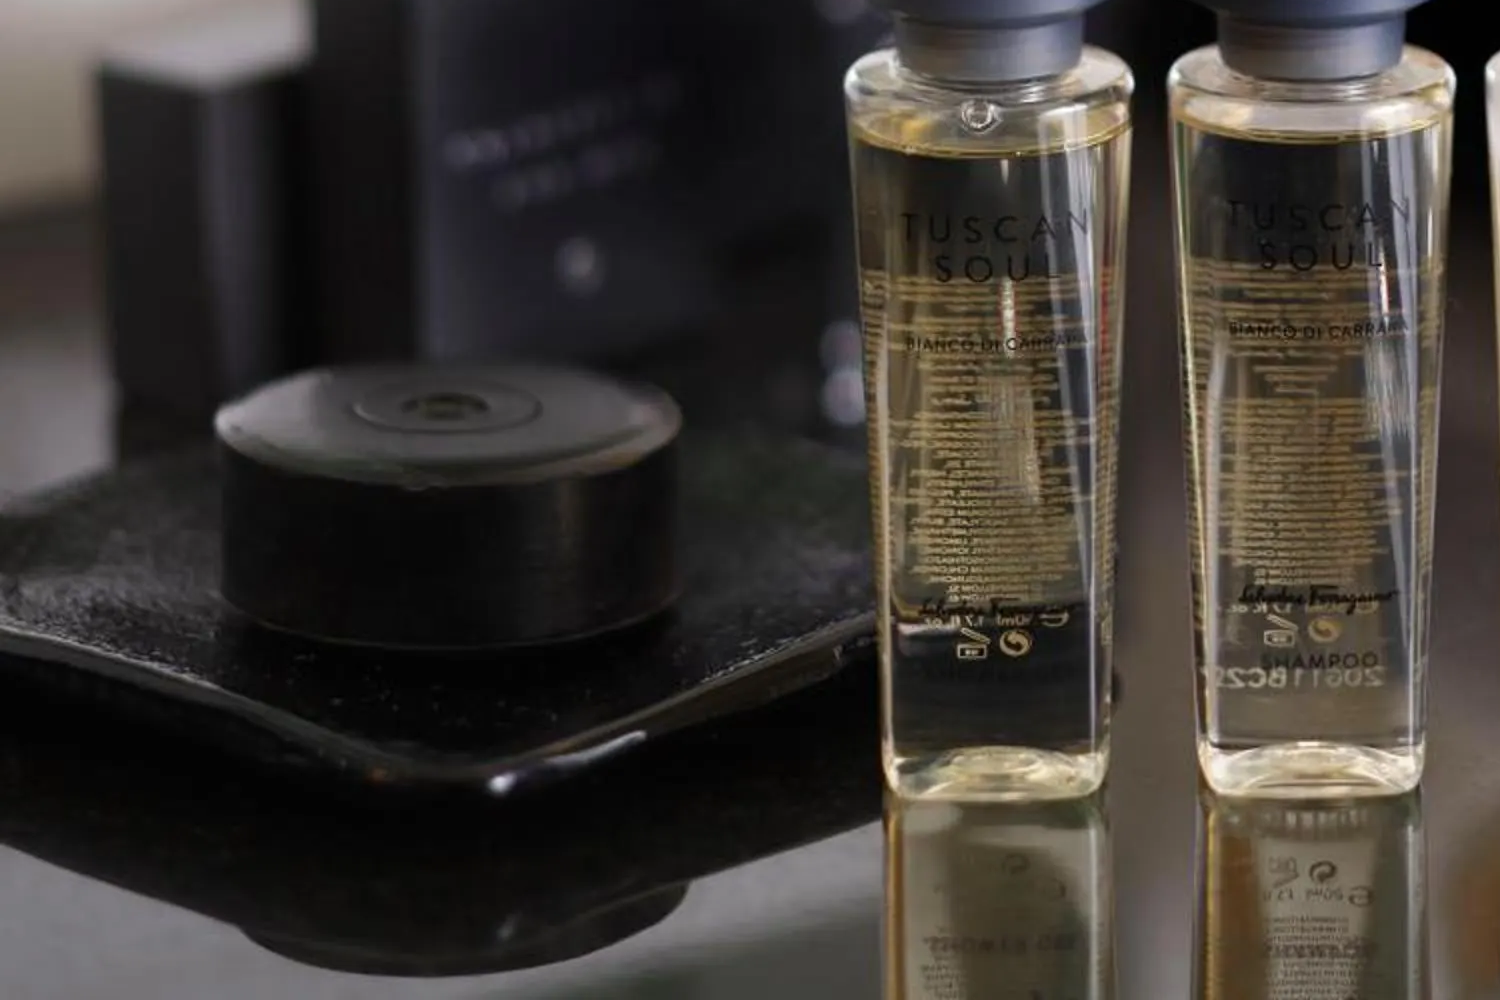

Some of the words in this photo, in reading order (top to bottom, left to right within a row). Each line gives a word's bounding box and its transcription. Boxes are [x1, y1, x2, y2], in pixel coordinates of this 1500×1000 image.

[901, 207, 1091, 244] TUSCAN
[1228, 197, 1410, 232] TUSCAN
[935, 252, 1062, 283] SOUL
[1259, 241, 1382, 272] SOUL
[1228, 321, 1298, 340] BIANCO
[1302, 325, 1322, 340] DI
[1261, 652, 1379, 671] SHAMPOO
